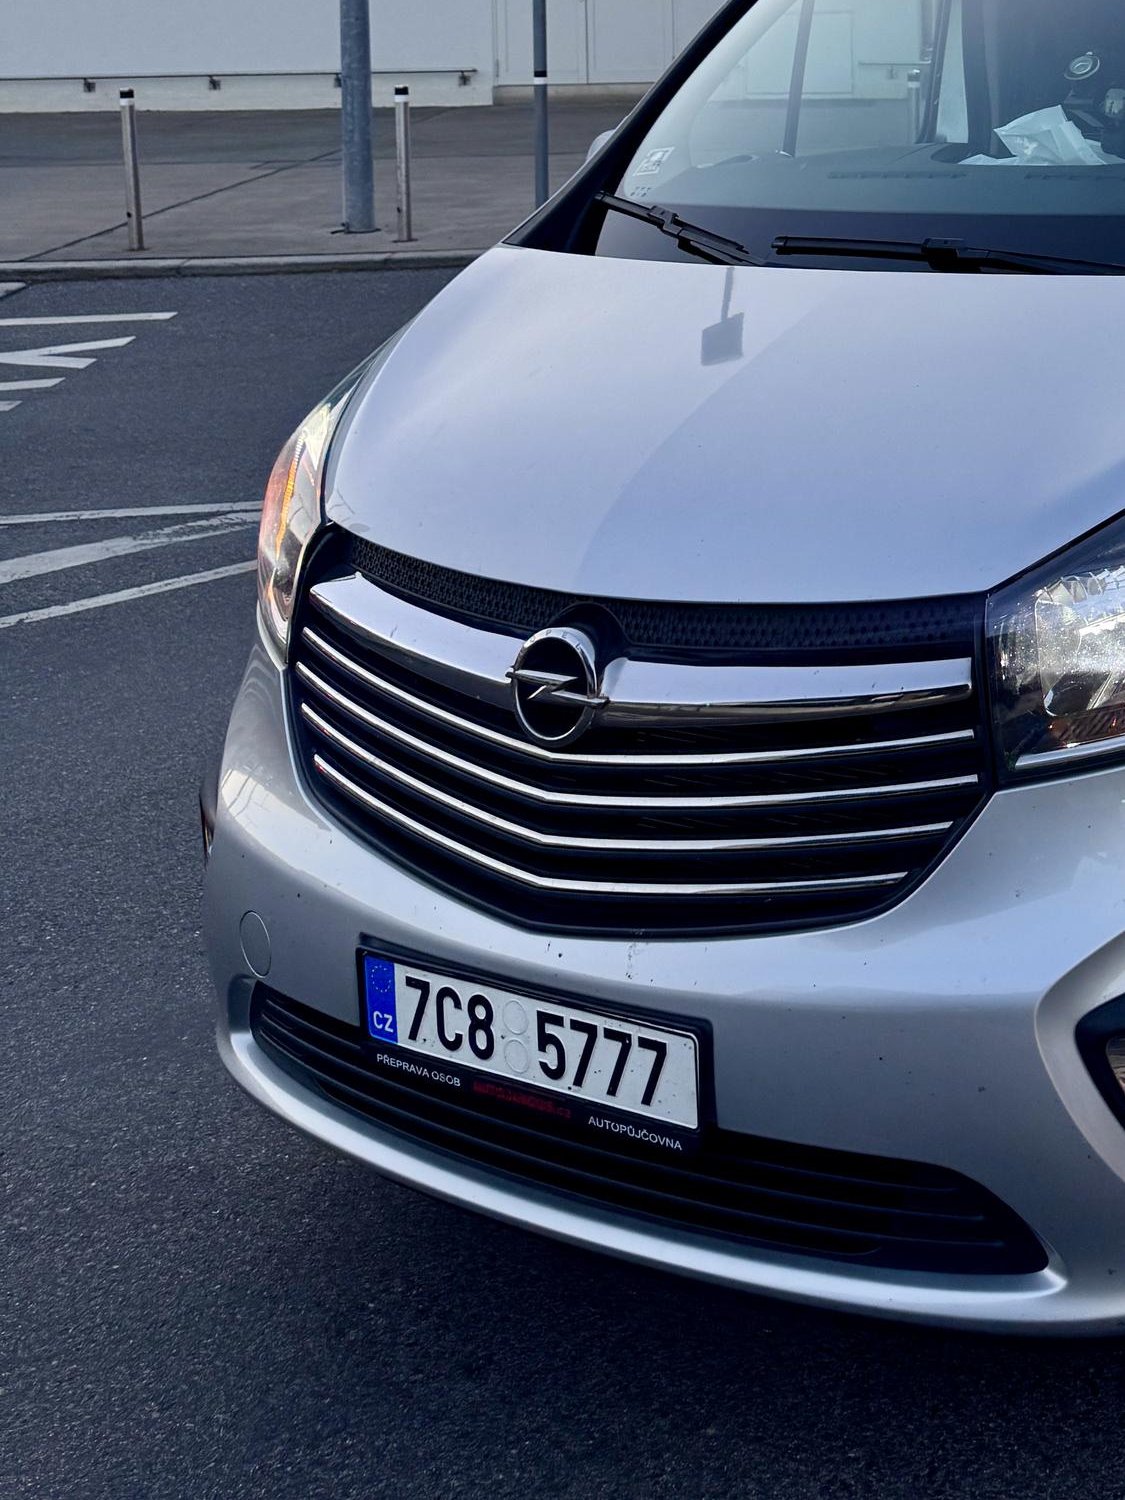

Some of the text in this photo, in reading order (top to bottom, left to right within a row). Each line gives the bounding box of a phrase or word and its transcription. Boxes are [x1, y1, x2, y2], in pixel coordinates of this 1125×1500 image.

[529, 629, 582, 651] OPEL
[372, 1009, 394, 1034] CZ
[405, 975, 495, 1061] 7C8
[536, 1009, 668, 1106] 5777
[431, 1070, 461, 1087] OSOB
